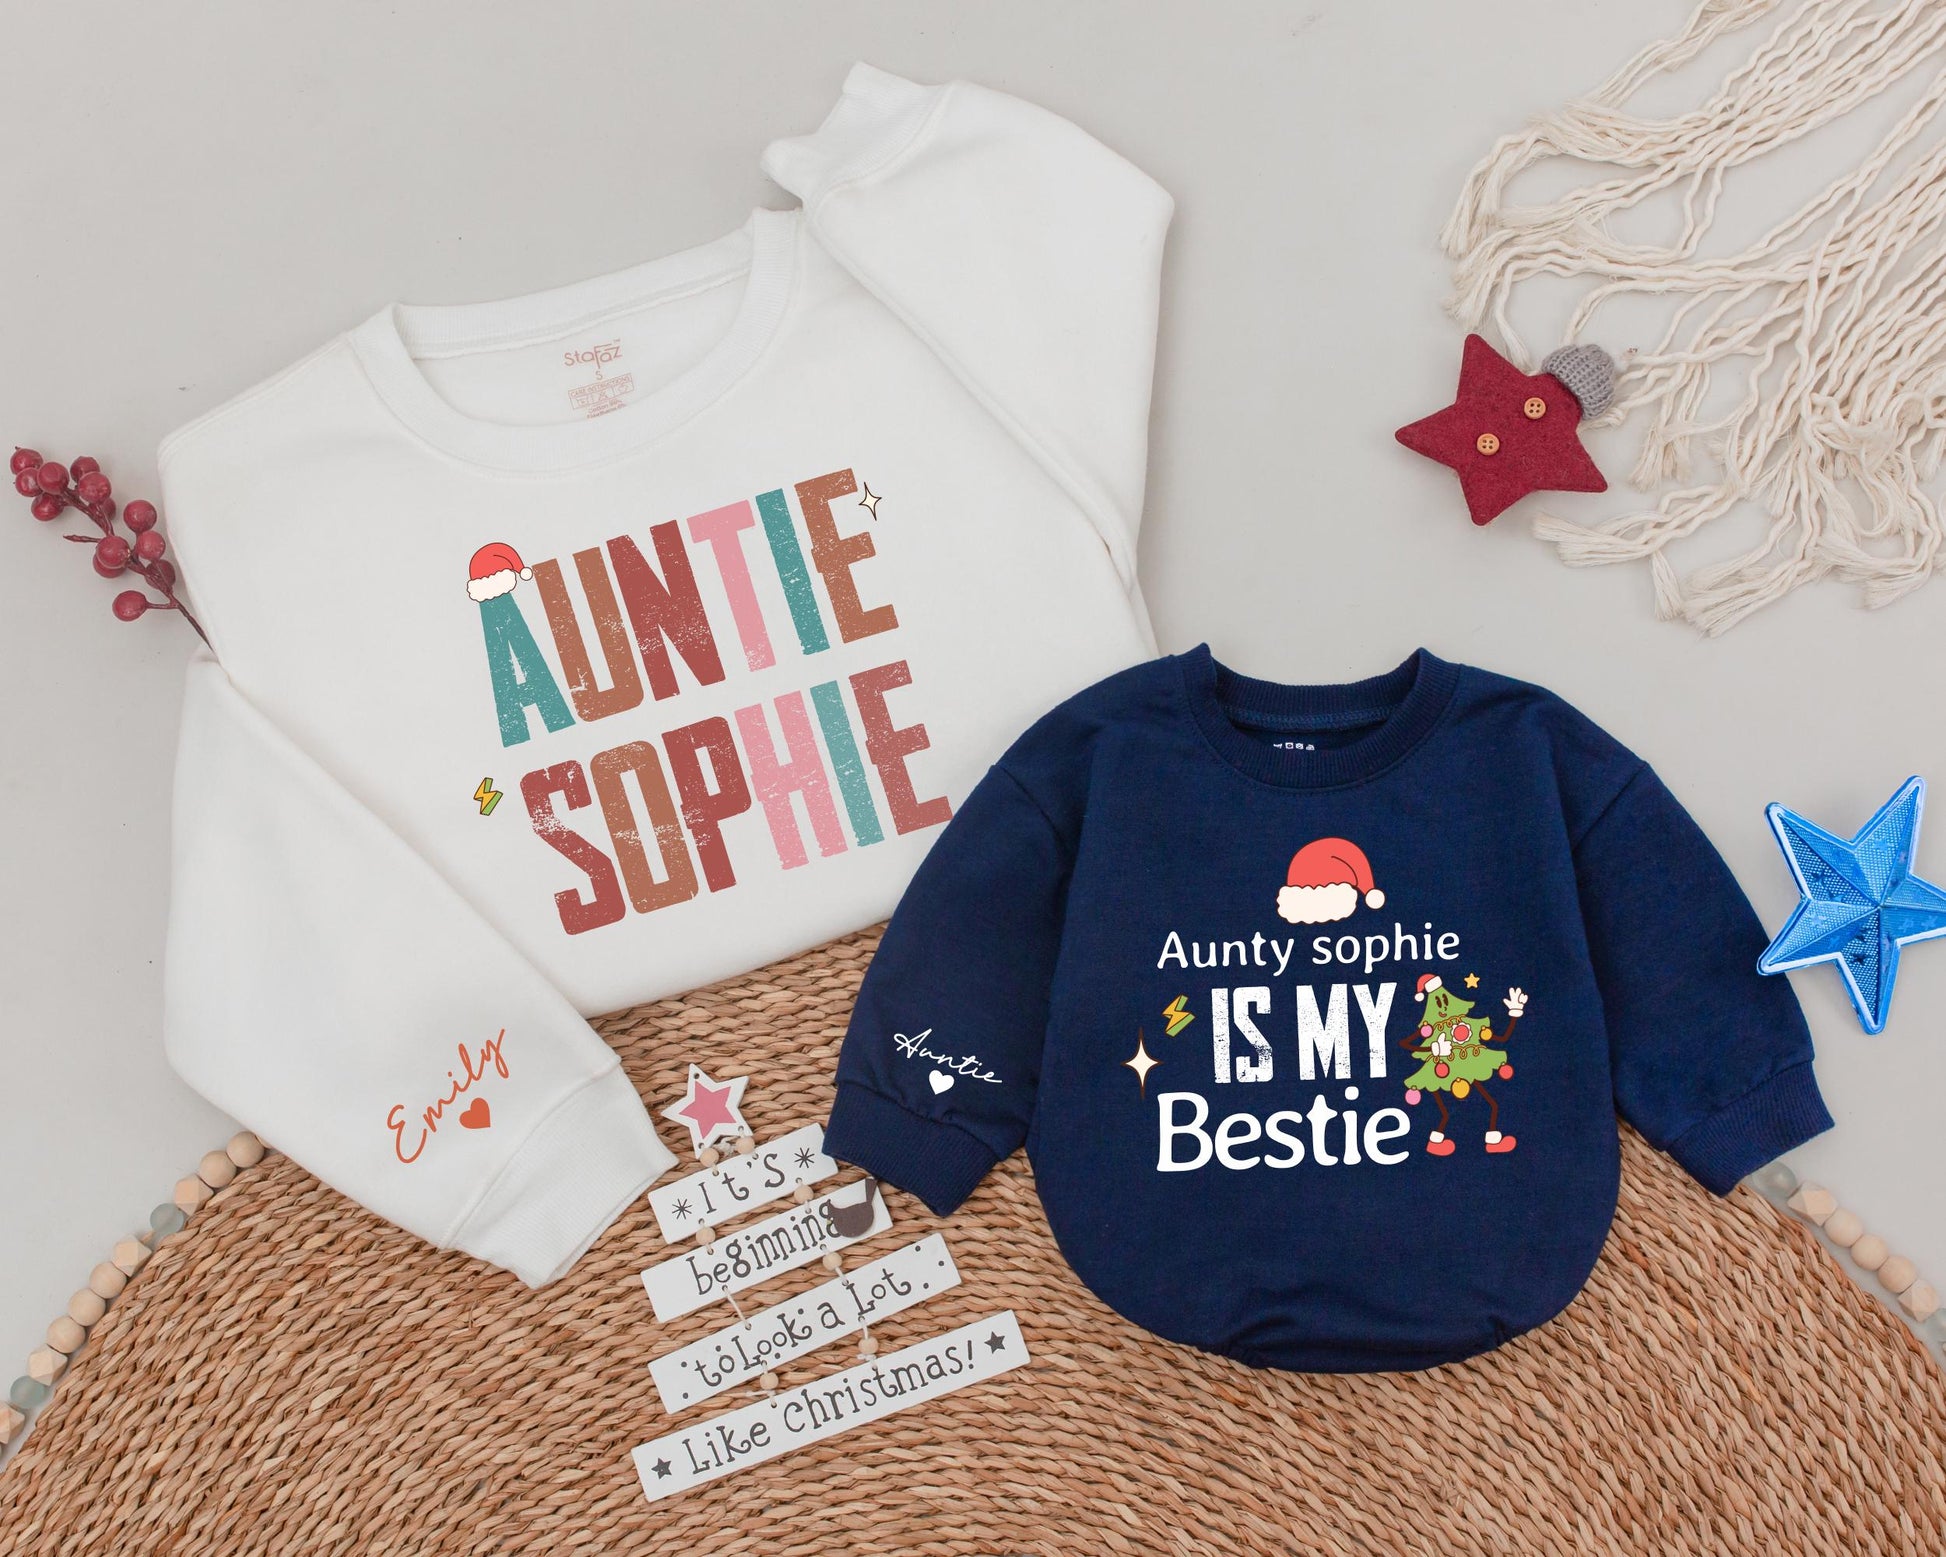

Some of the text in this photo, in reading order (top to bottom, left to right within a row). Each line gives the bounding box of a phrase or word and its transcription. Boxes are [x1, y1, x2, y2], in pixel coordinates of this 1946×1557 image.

[595, 371, 603, 380] S
[478, 467, 900, 748] AUNTIE
[519, 659, 955, 936] SOPHIE
[1157, 922, 1461, 977] Aunty sophie
[893, 1027, 1003, 1084] Auntie
[1210, 981, 1398, 1084] IS MY
[386, 1028, 510, 1164] Emily
[1156, 1086, 1411, 1173] Bestie
[685, 1198, 842, 1296] beginning
[816, 1301, 846, 1330] a
[681, 1339, 975, 1476] Like Christmas!
